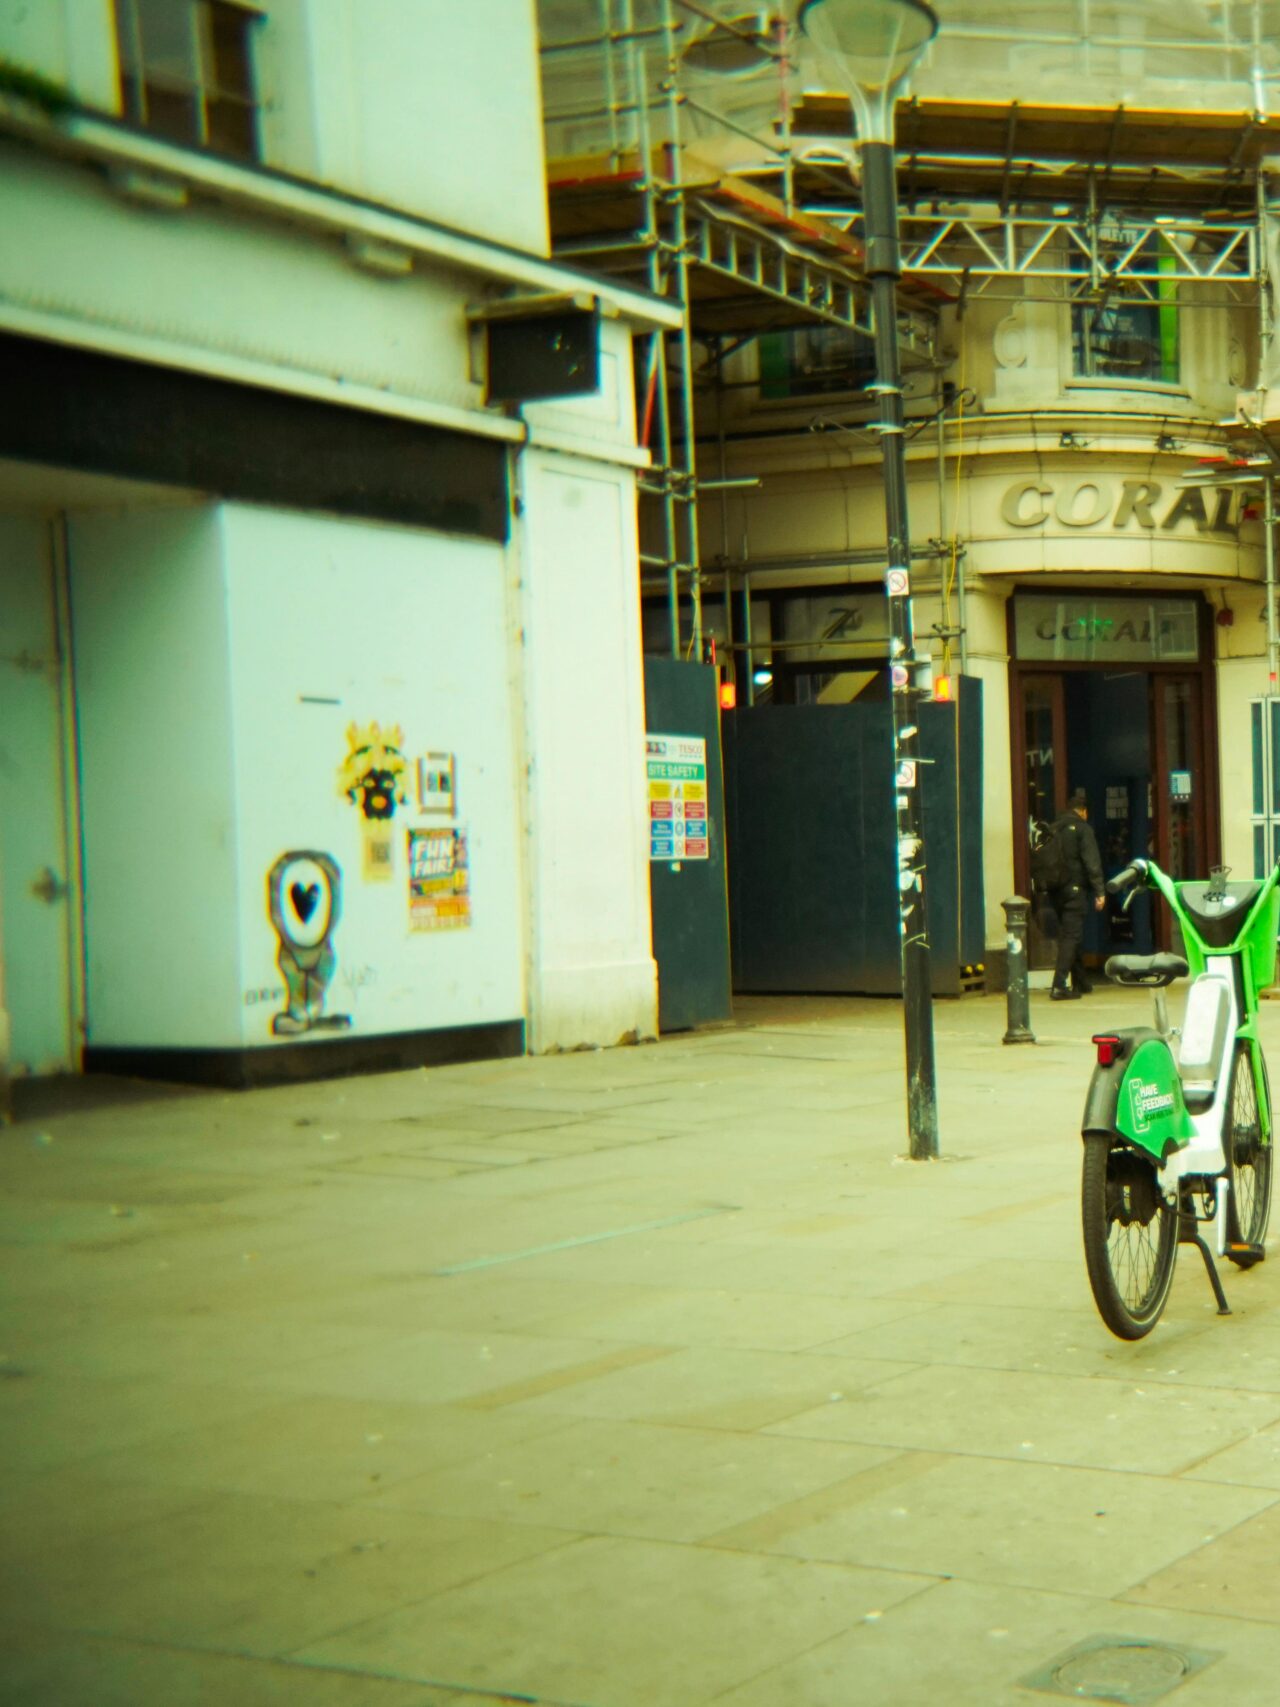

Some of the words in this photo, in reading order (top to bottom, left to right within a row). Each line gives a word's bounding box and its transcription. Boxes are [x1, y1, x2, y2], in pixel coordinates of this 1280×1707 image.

[1001, 480, 1240, 533] CORAL
[679, 744, 703, 754] TESCO
[648, 764, 666, 777] SITE
[668, 765, 698, 778] SAFETY
[414, 839, 452, 861] FUN
[1140, 1084, 1158, 1097] HAVE
